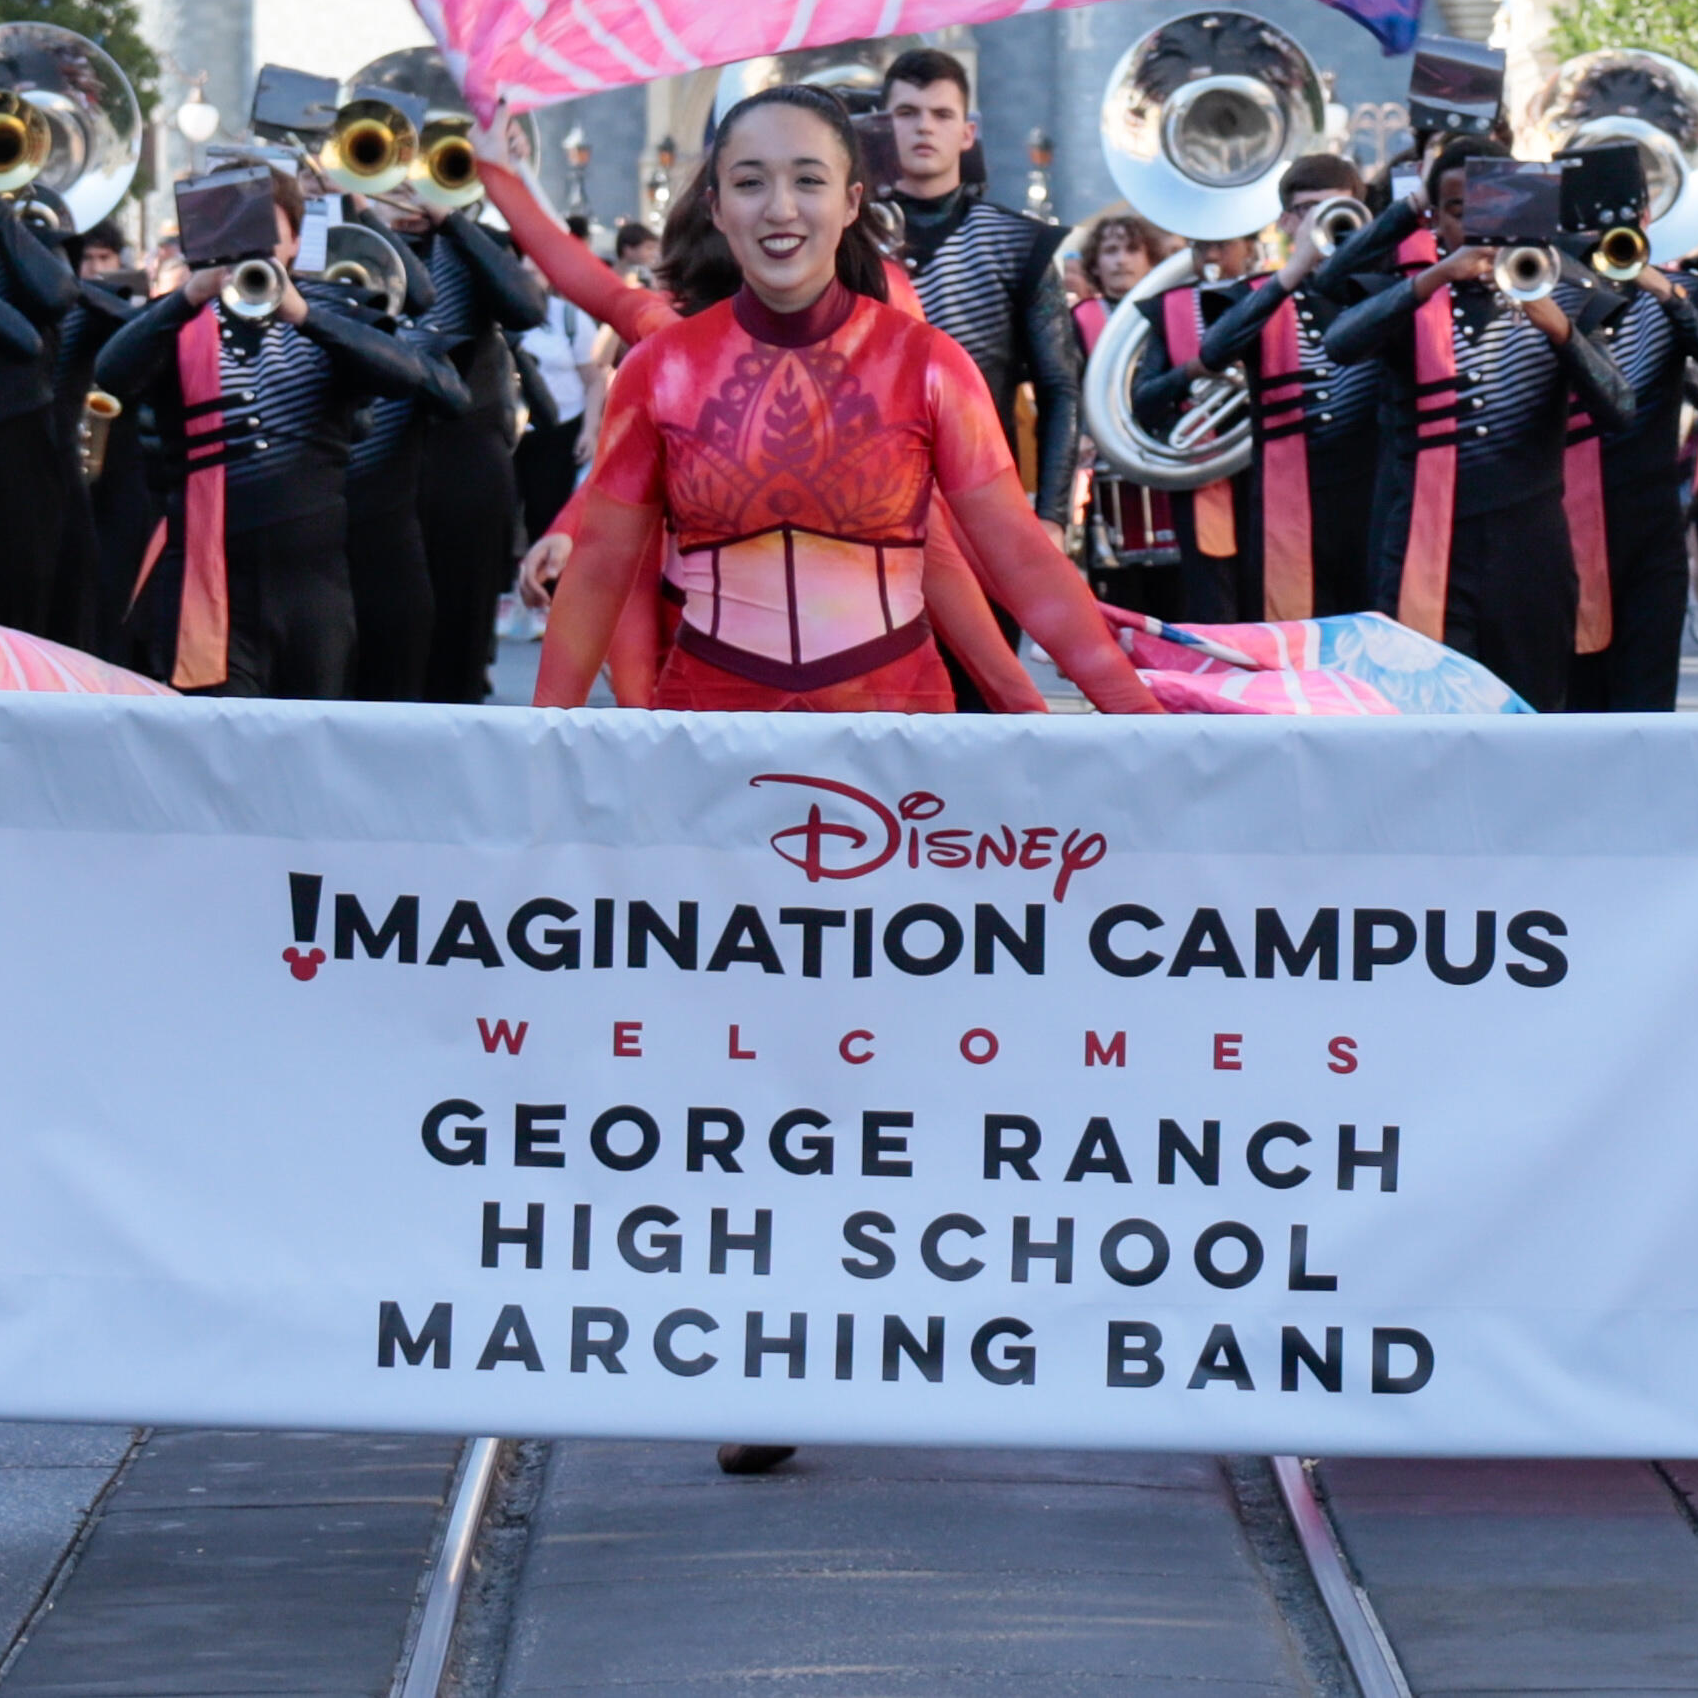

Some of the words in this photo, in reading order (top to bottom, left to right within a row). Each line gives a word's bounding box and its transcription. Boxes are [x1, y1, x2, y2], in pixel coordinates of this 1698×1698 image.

[748, 772, 1108, 904] Disney
[1087, 902, 1569, 989] CAMPUS
[476, 1017, 1359, 1075] WELCOMES
[420, 1098, 915, 1178] GEORGE
[982, 1113, 1400, 1193] RANCH
[480, 1201, 773, 1275] HIGH
[841, 1210, 1340, 1293] SCHOOL
[377, 1301, 1037, 1386] MARCHING
[1106, 1320, 1435, 1395] BAND
